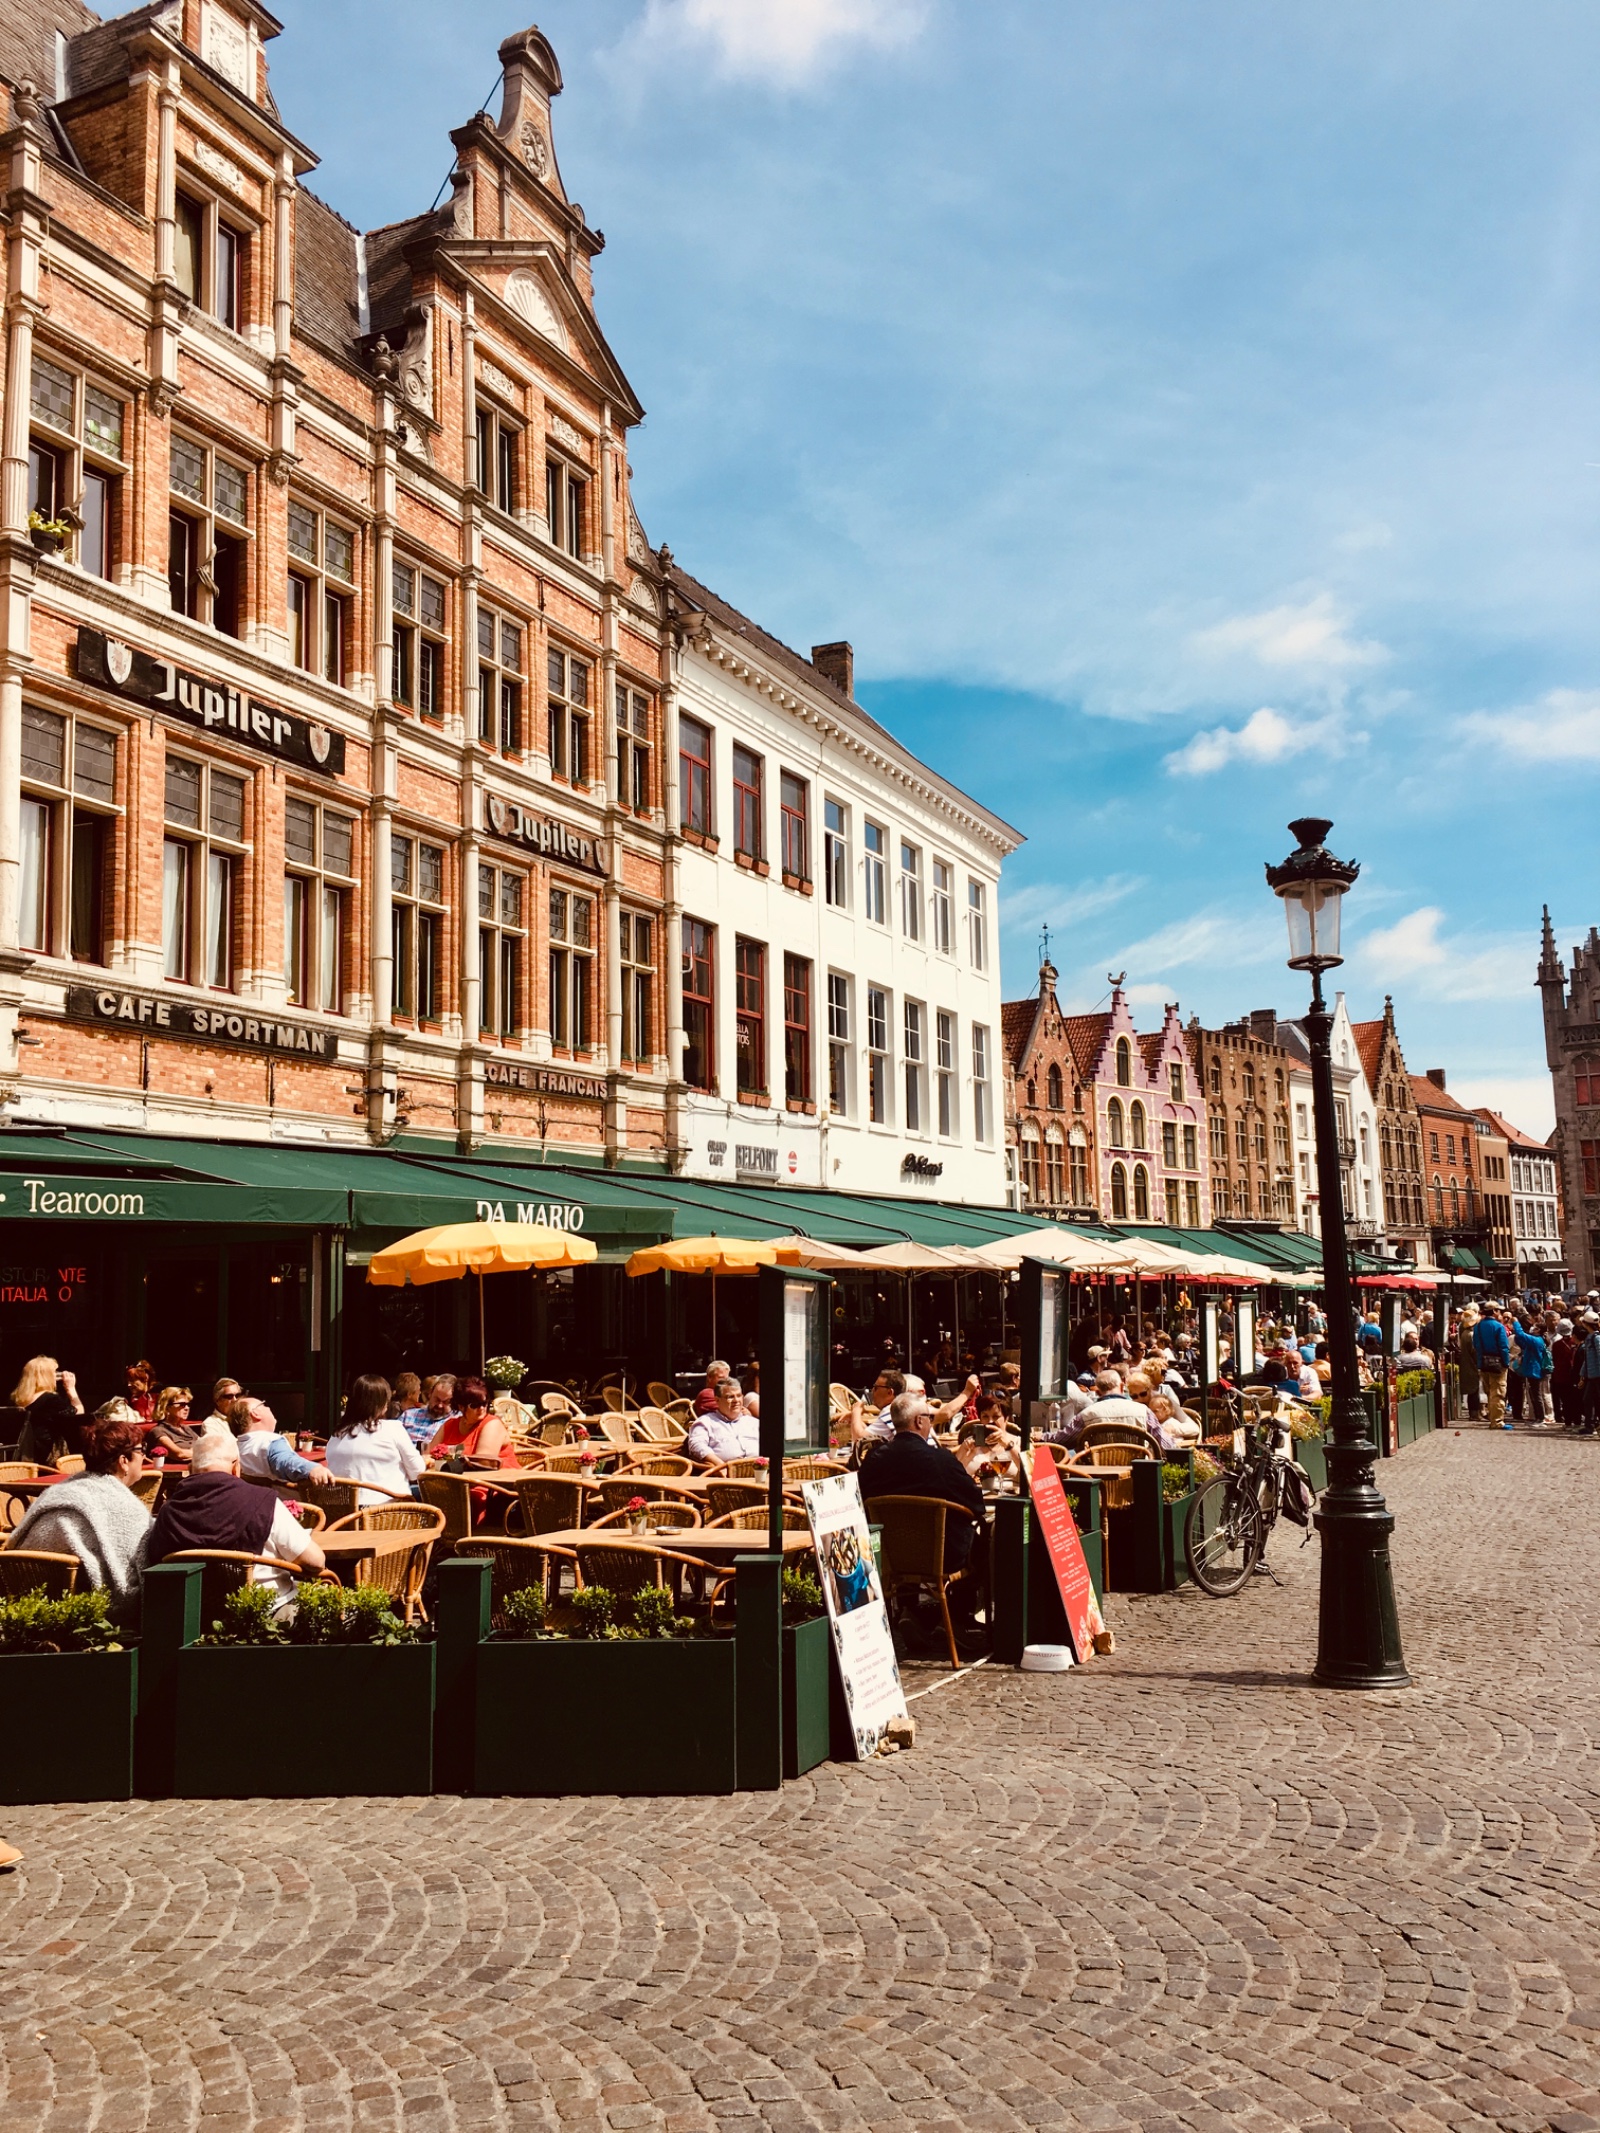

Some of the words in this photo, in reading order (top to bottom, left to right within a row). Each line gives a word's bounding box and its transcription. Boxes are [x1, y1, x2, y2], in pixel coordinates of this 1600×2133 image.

[152, 658, 292, 746] Jupiler
[508, 804, 591, 860] Jupiler
[97, 991, 171, 1026] CAFE
[192, 1008, 326, 1054] SPORTMAN
[487, 1063, 528, 1087] CAFE
[707, 1139, 728, 1154] GRAND
[735, 1144, 778, 1172] BELFORT
[23, 1180, 145, 1215] Tearoom
[476, 1201, 506, 1223] DA
[517, 1202, 584, 1231] MARIO
